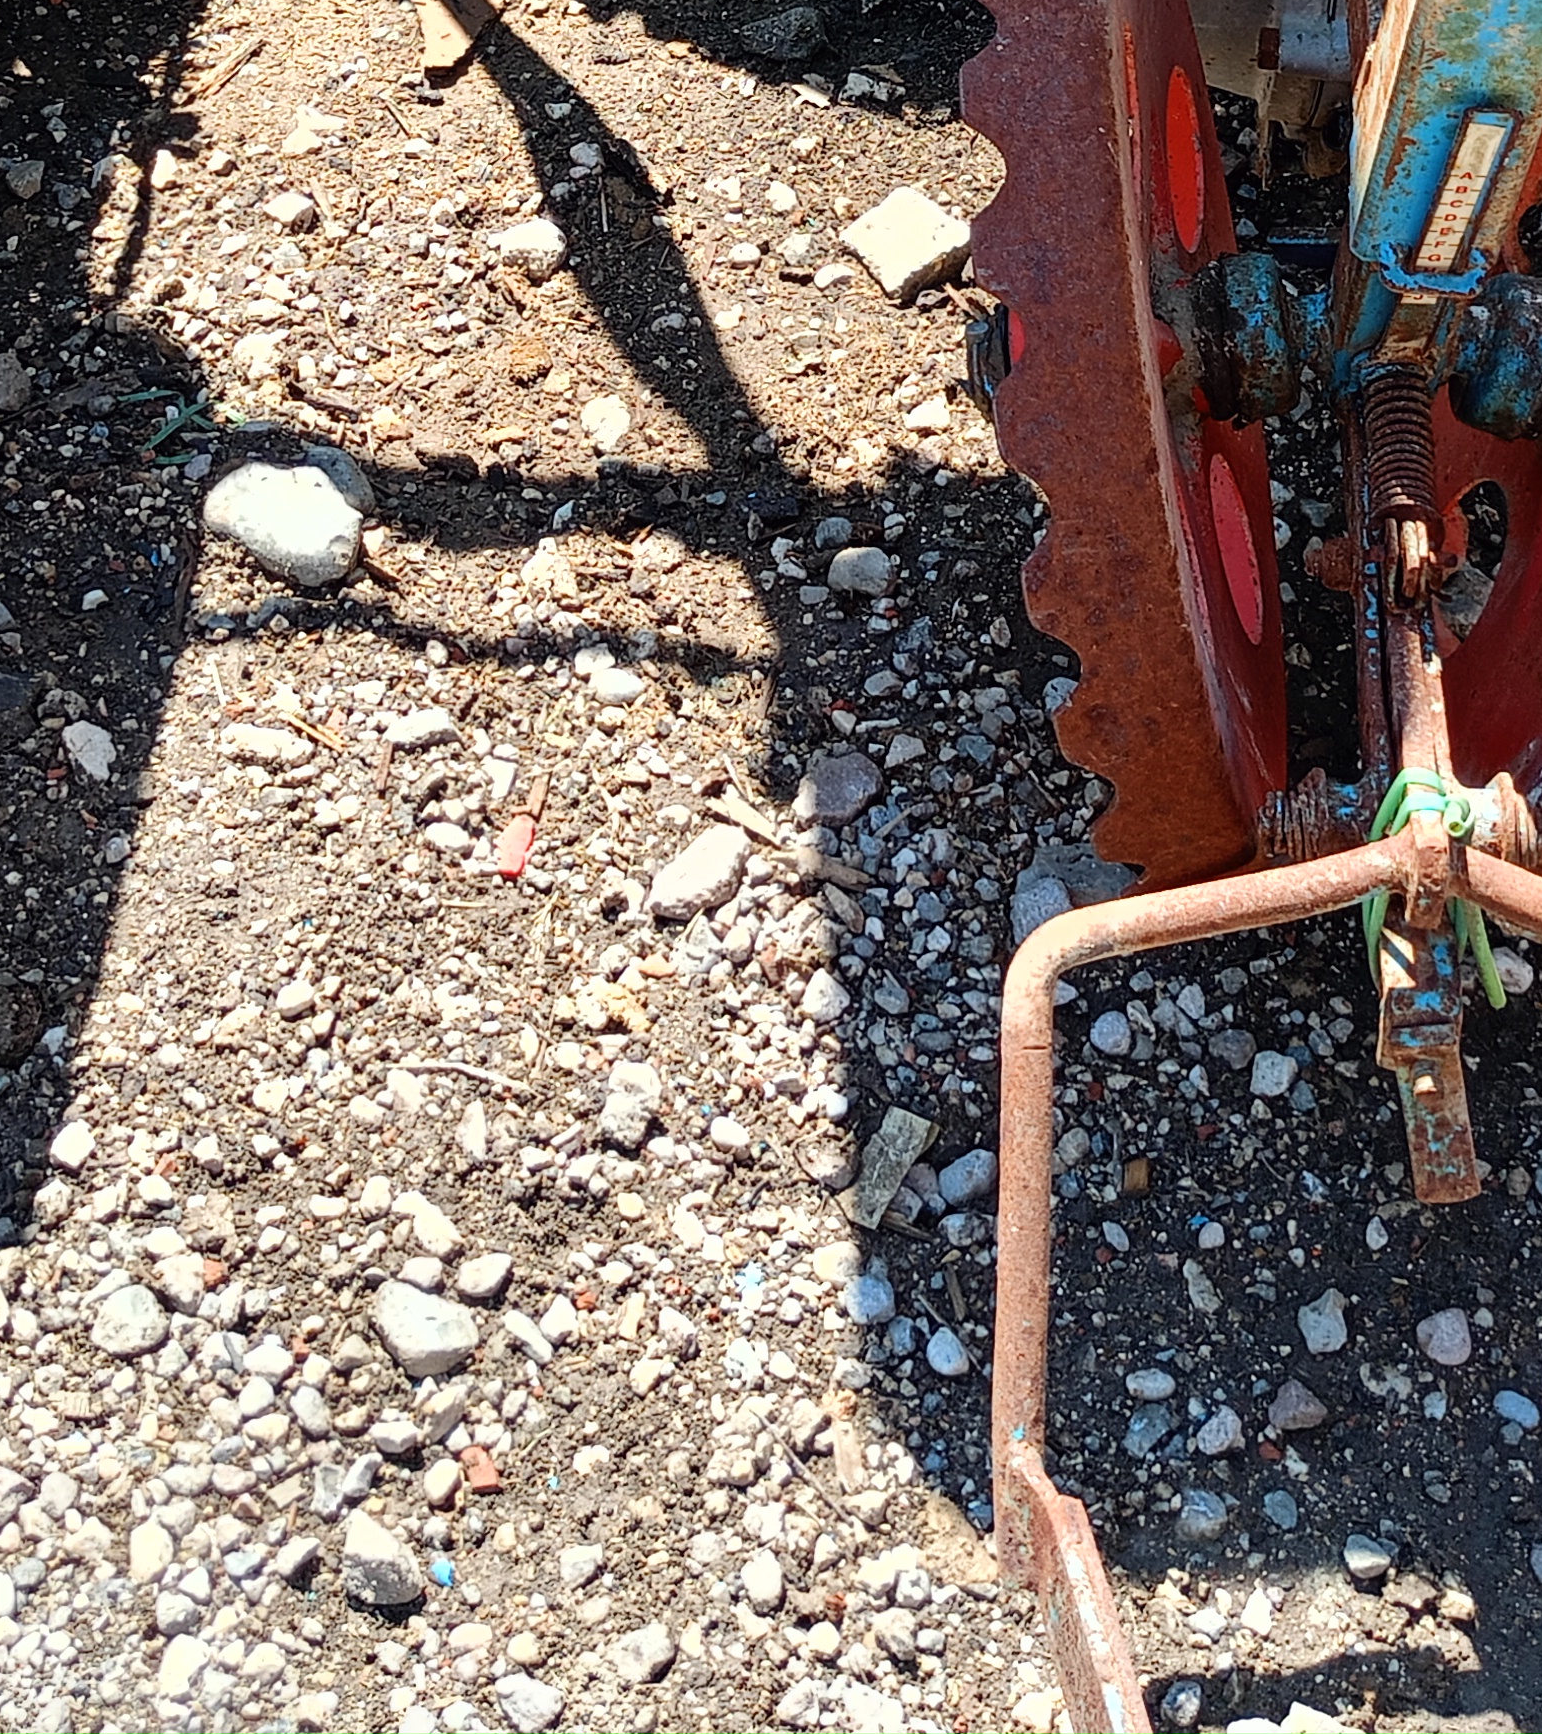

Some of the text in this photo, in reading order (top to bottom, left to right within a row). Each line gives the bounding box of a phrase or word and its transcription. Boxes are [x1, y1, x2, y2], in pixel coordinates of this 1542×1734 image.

[1460, 172, 1473, 180] A
[1455, 186, 1468, 194] B
[1450, 200, 1464, 208] C
[1440, 228, 1451, 236] E
[1427, 254, 1441, 262] G
